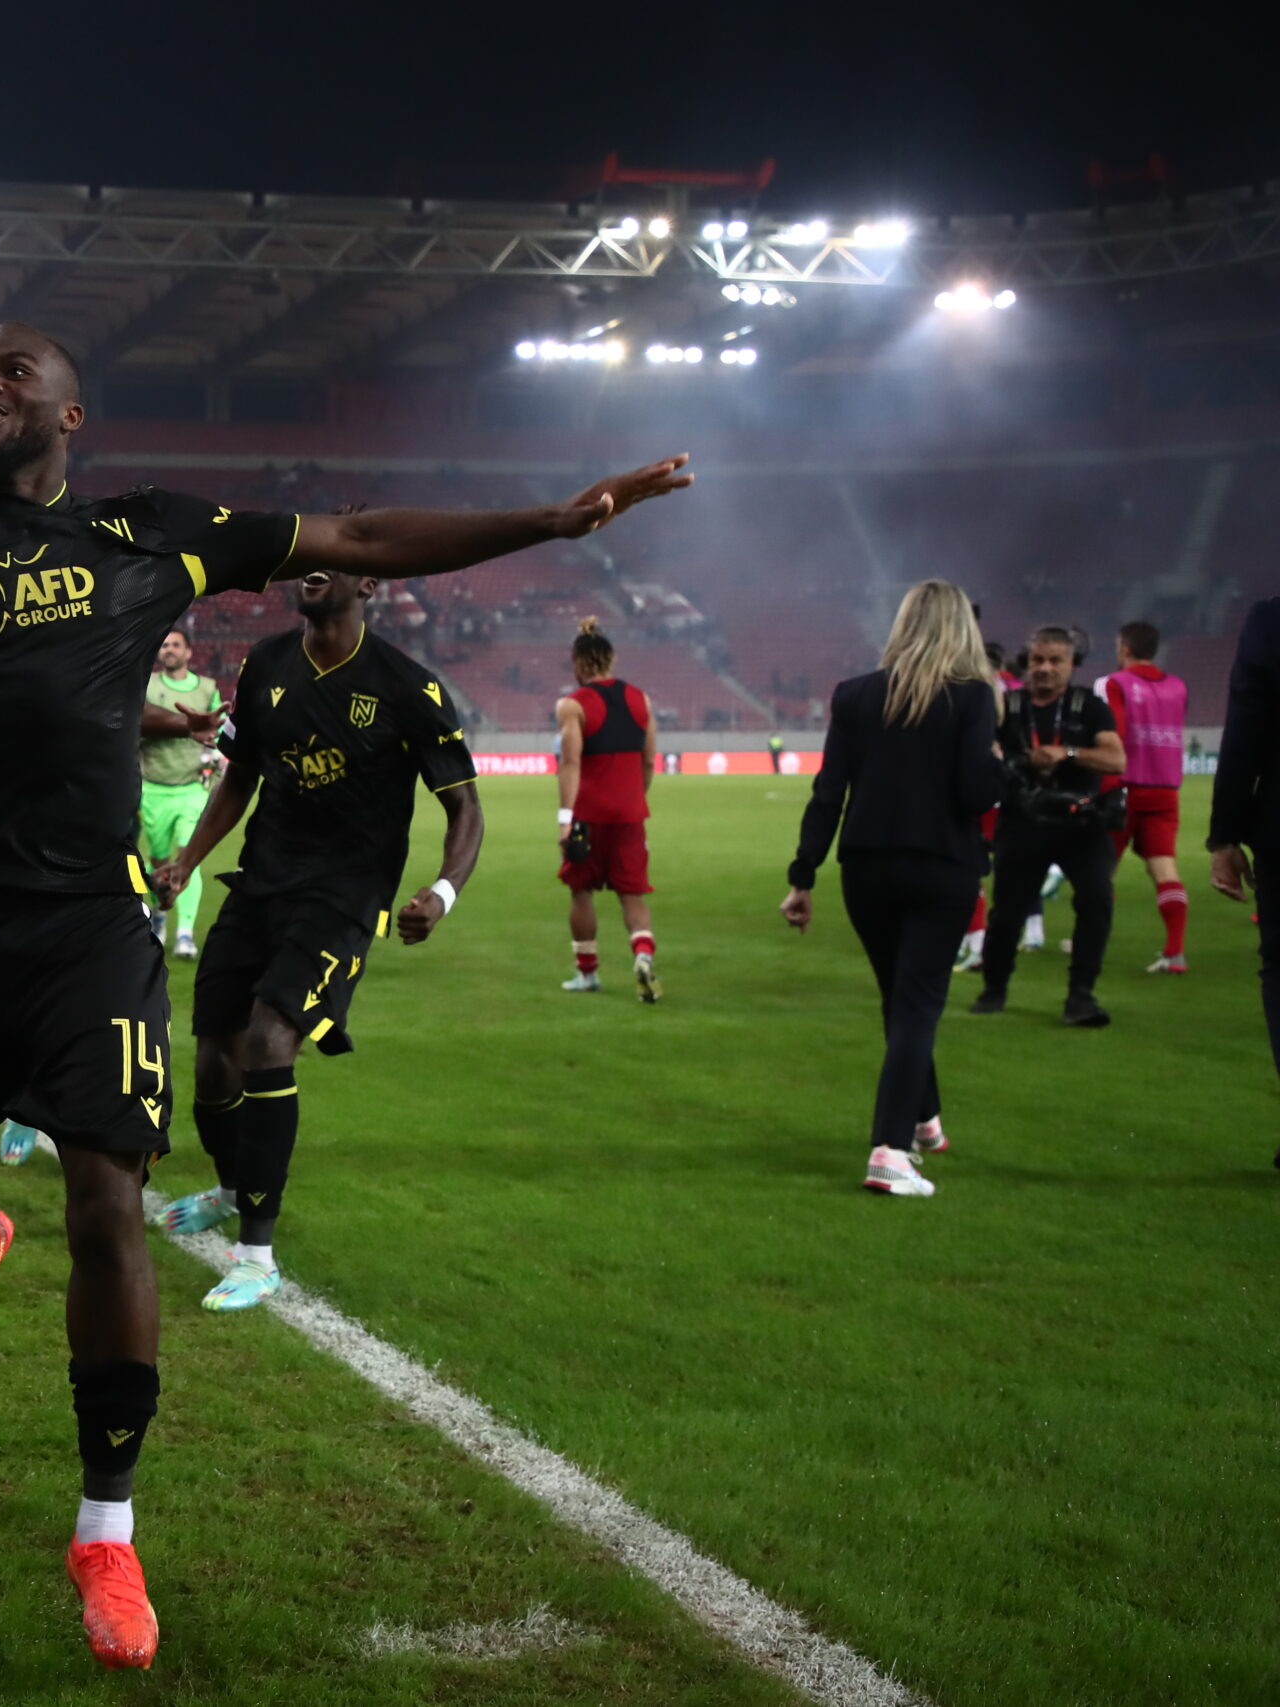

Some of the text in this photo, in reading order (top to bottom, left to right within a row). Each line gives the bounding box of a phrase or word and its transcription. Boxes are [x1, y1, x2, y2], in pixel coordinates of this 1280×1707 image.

[14, 566, 95, 611] AFD
[16, 600, 92, 627] GROUPE
[301, 747, 347, 780] AFD
[317, 950, 340, 994] 7
[111, 1018, 165, 1097] 14
